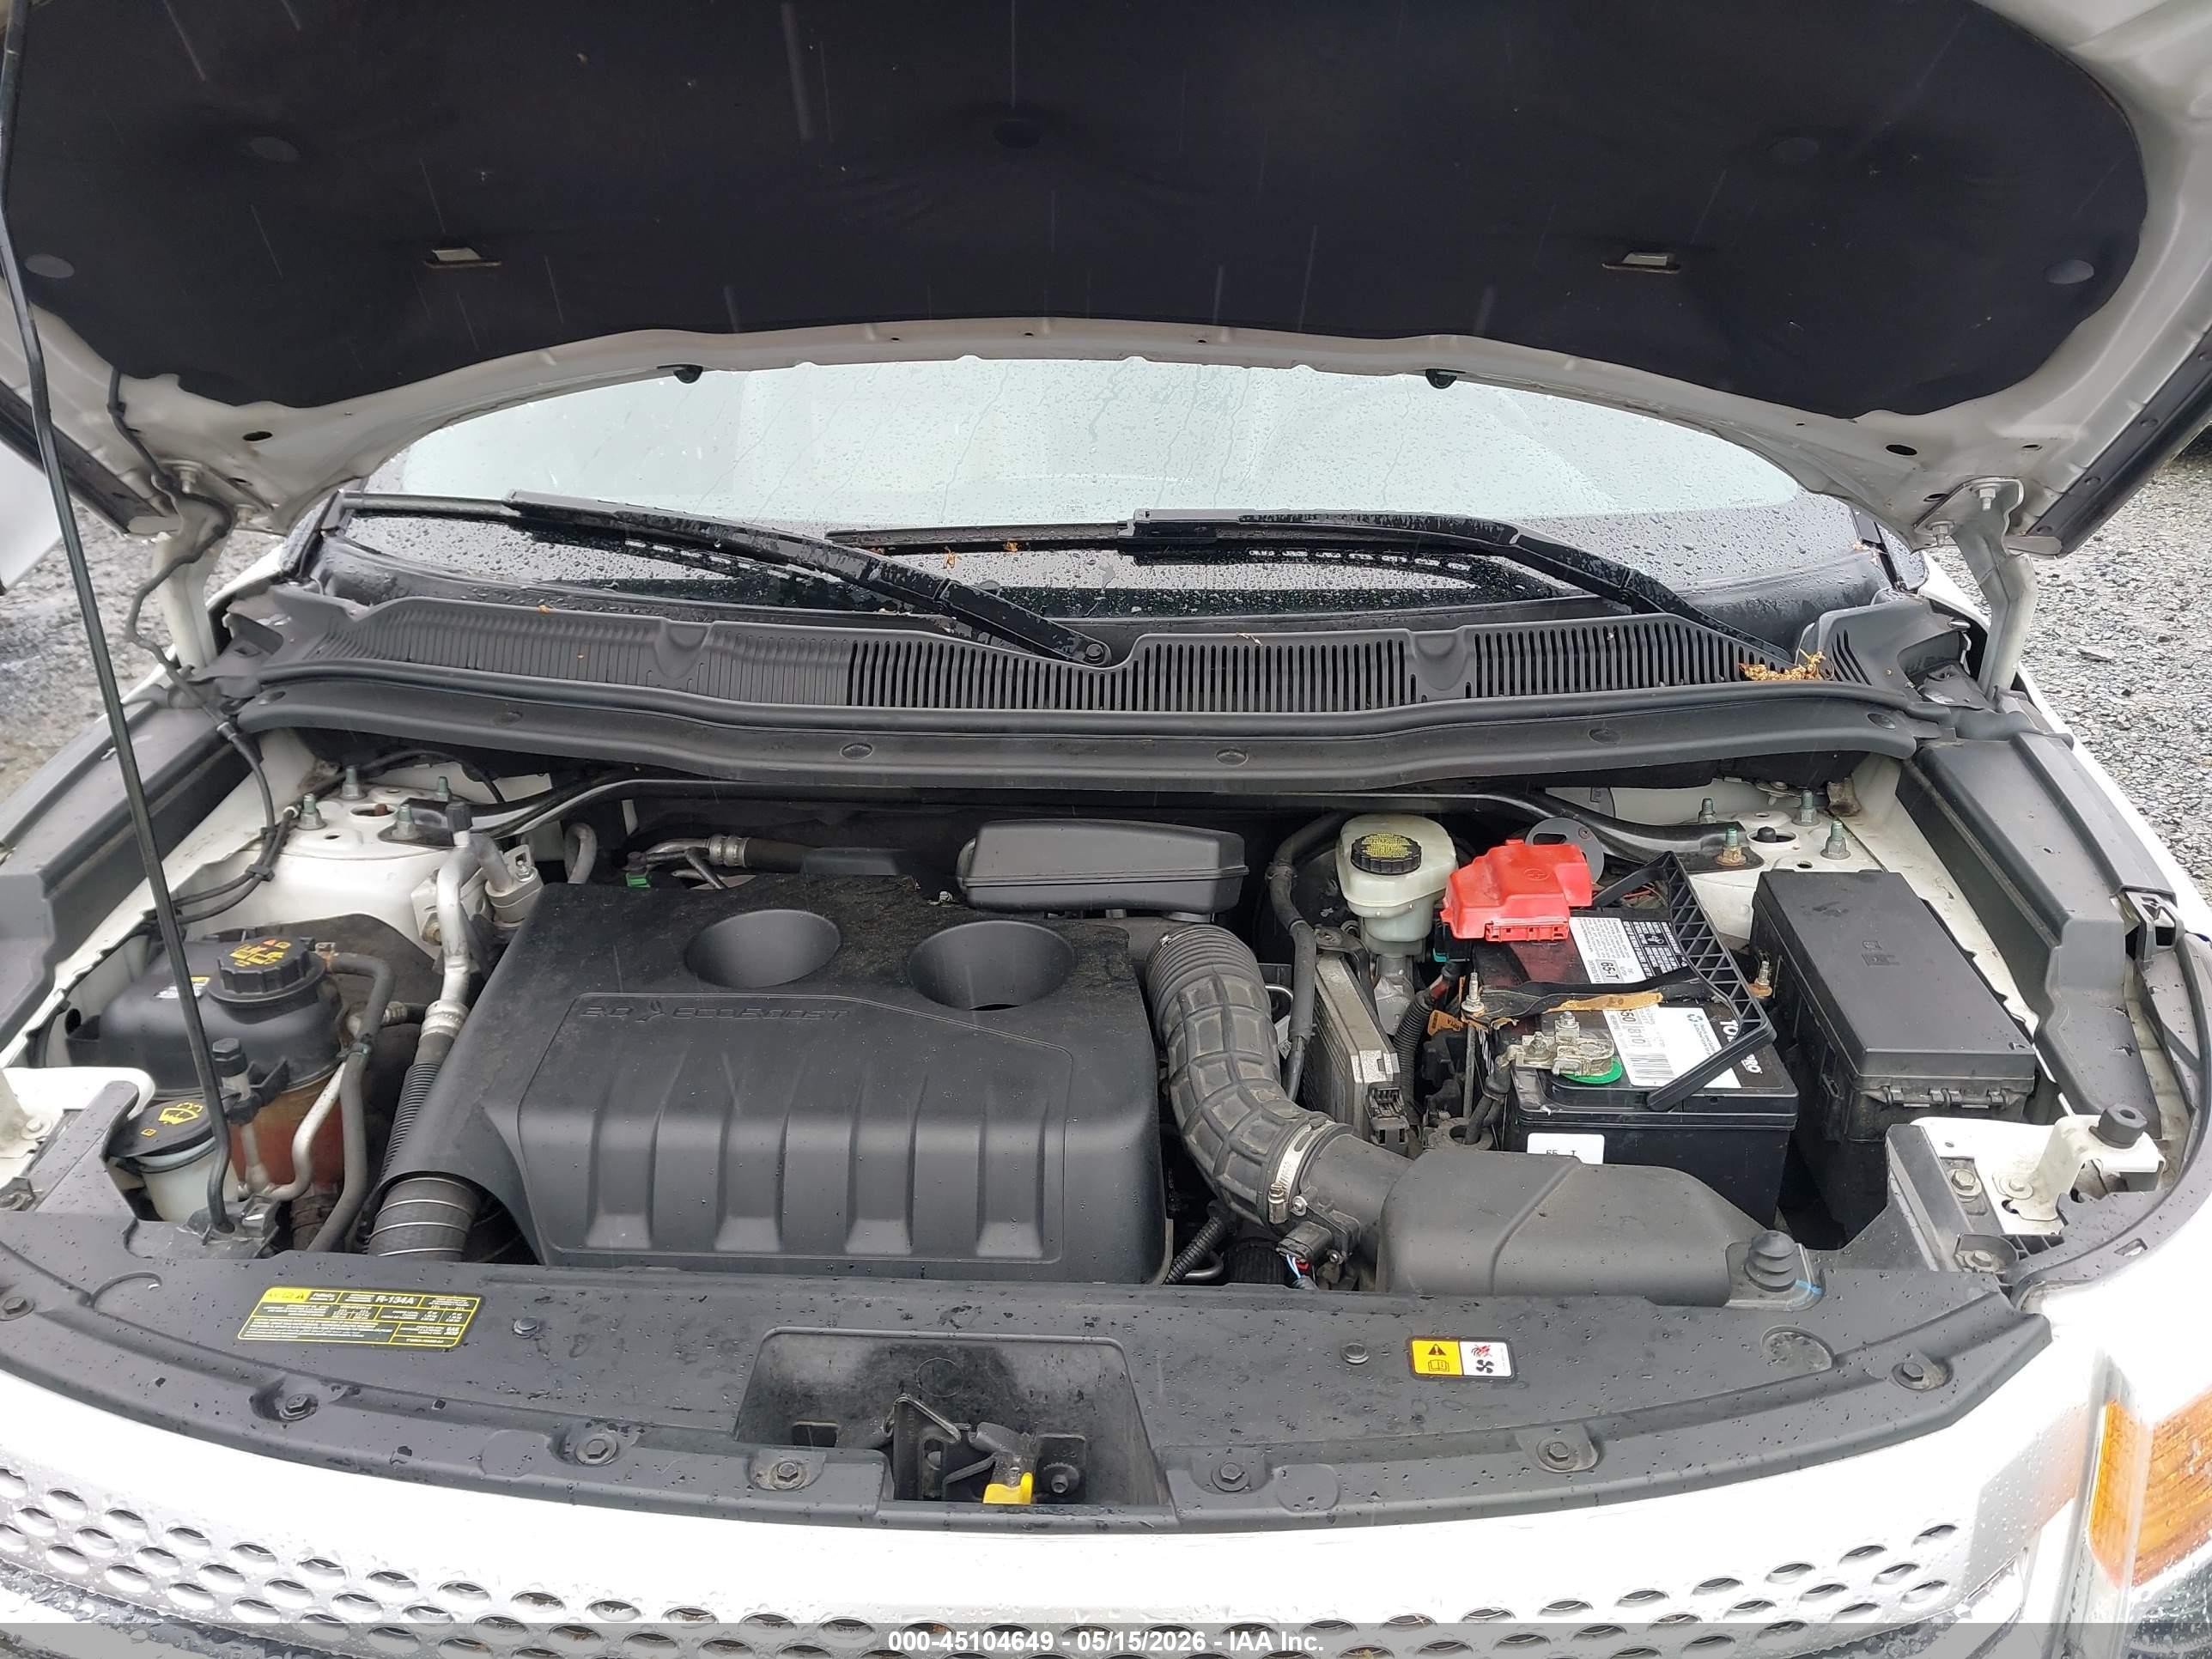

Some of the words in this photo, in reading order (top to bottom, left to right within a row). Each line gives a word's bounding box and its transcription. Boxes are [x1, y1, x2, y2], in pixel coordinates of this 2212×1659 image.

[1601, 962, 1620, 979] 65-T
[579, 1006, 634, 1018] 2.0
[1620, 1009, 1637, 1022] 50
[1627, 1028, 1646, 1044] 810
[375, 1295, 415, 1304] R-134A
